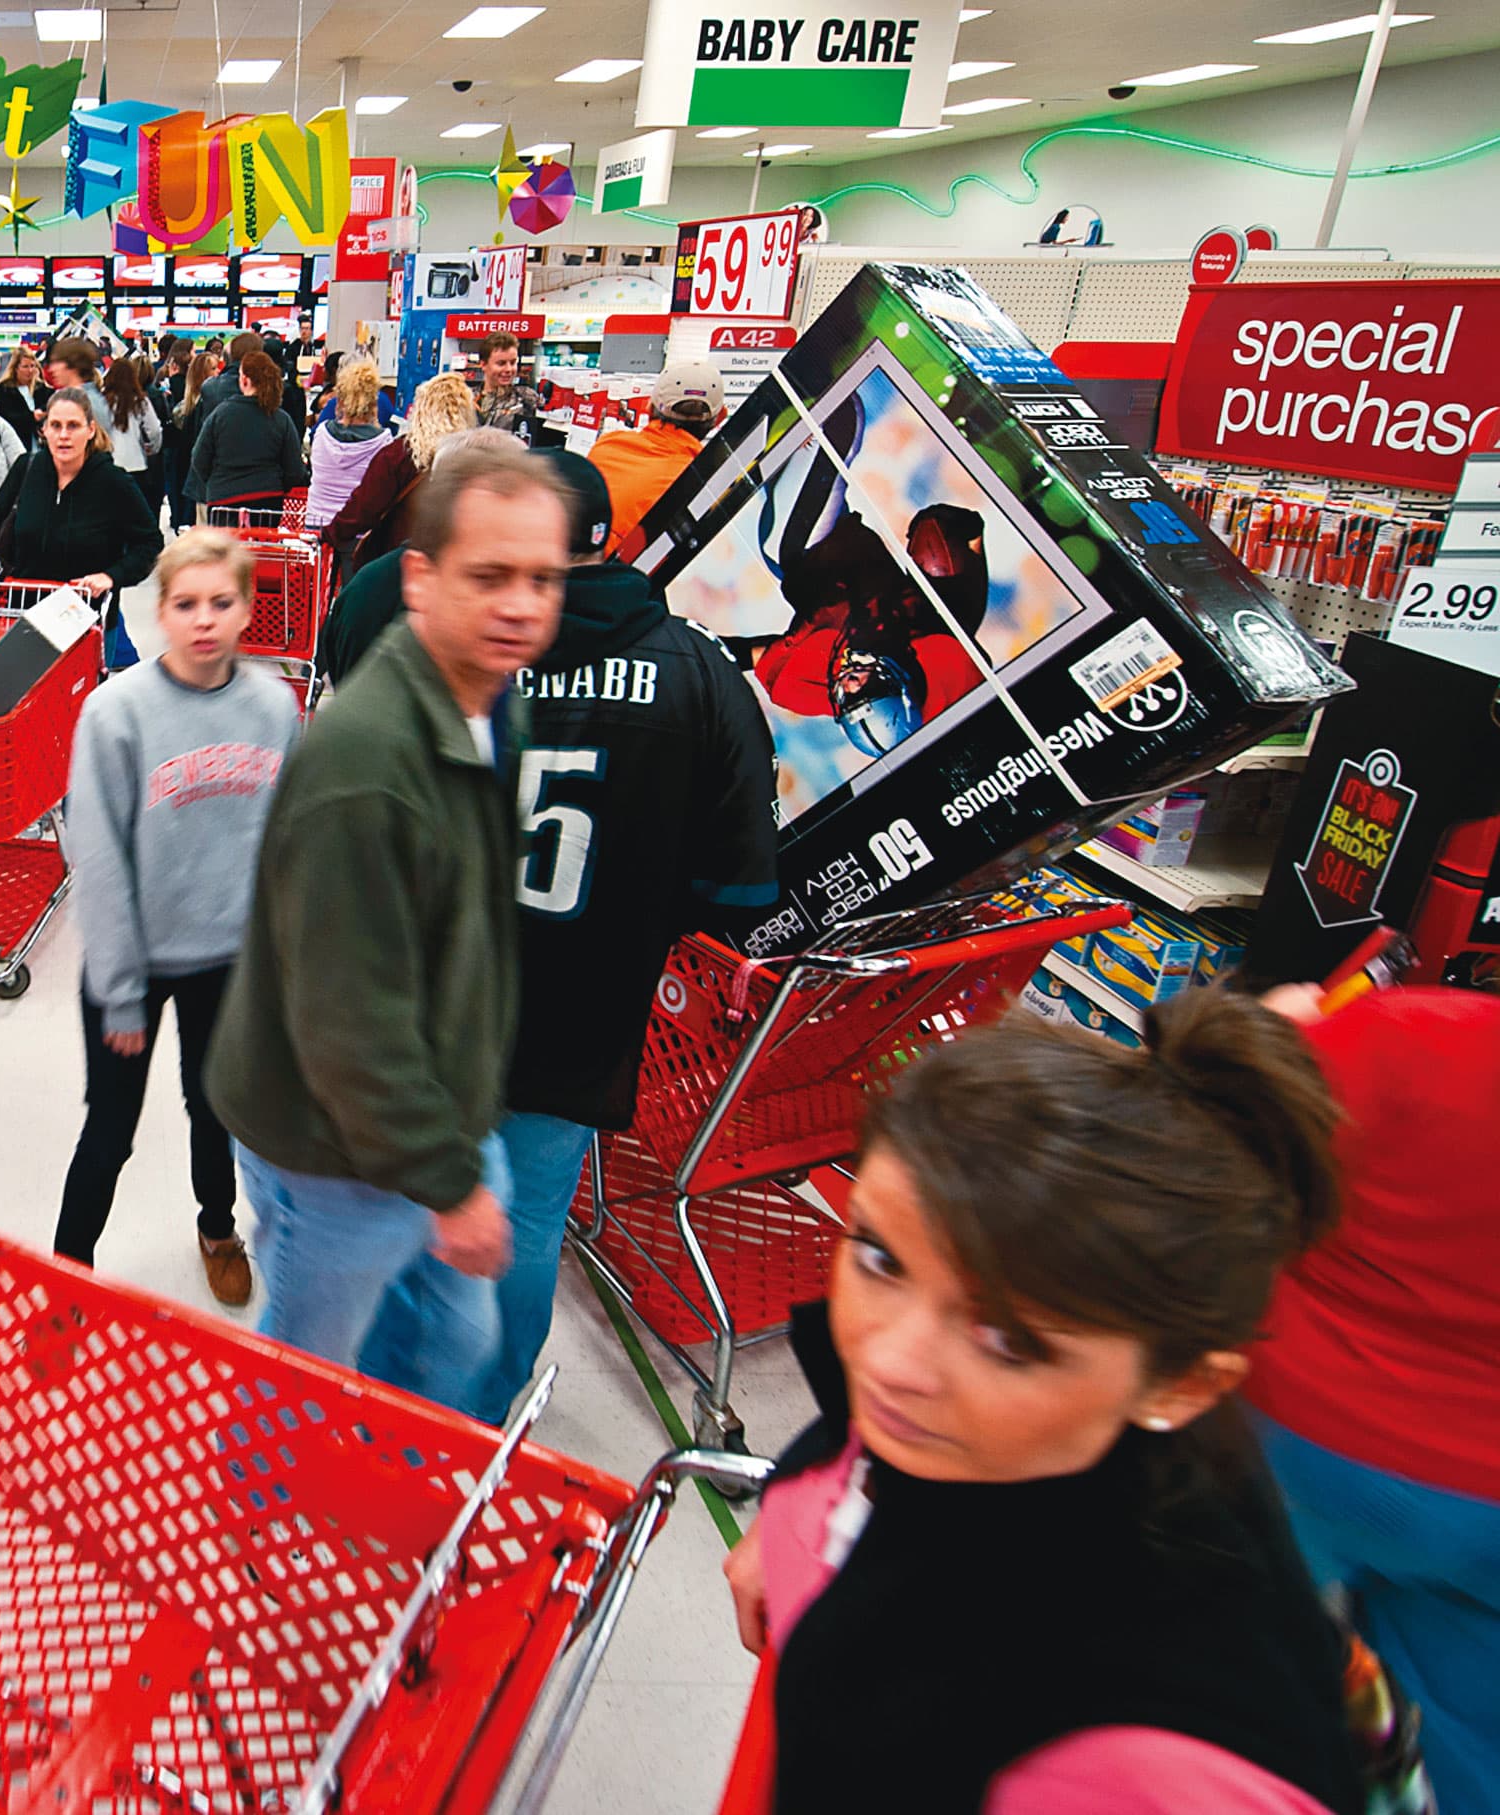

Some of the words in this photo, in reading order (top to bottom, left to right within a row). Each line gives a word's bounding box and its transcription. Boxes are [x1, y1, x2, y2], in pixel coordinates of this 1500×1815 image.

[696, 19, 805, 62] BABY
[817, 19, 920, 63] CARE
[64, 100, 350, 249] FUN
[352, 177, 382, 187] PRICE
[458, 320, 529, 332] BATTERIES
[1233, 305, 1463, 381] special
[731, 358, 750, 366] Baby
[1403, 582, 1498, 621] 2.99
[1399, 619, 1430, 629] Expect
[1459, 622, 1475, 632] Pay
[941, 711, 1113, 827] Wesinghouse
[1342, 779, 1373, 813] IT'S
[1322, 824, 1388, 870] FRIDAY
[1330, 805, 1394, 850] BLACK
[807, 852, 859, 896] HDTV
[826, 868, 869, 901] LCD
[1317, 851, 1367, 904] SALE
[821, 882, 879, 926] 1080P
[744, 907, 800, 949] 1080P
